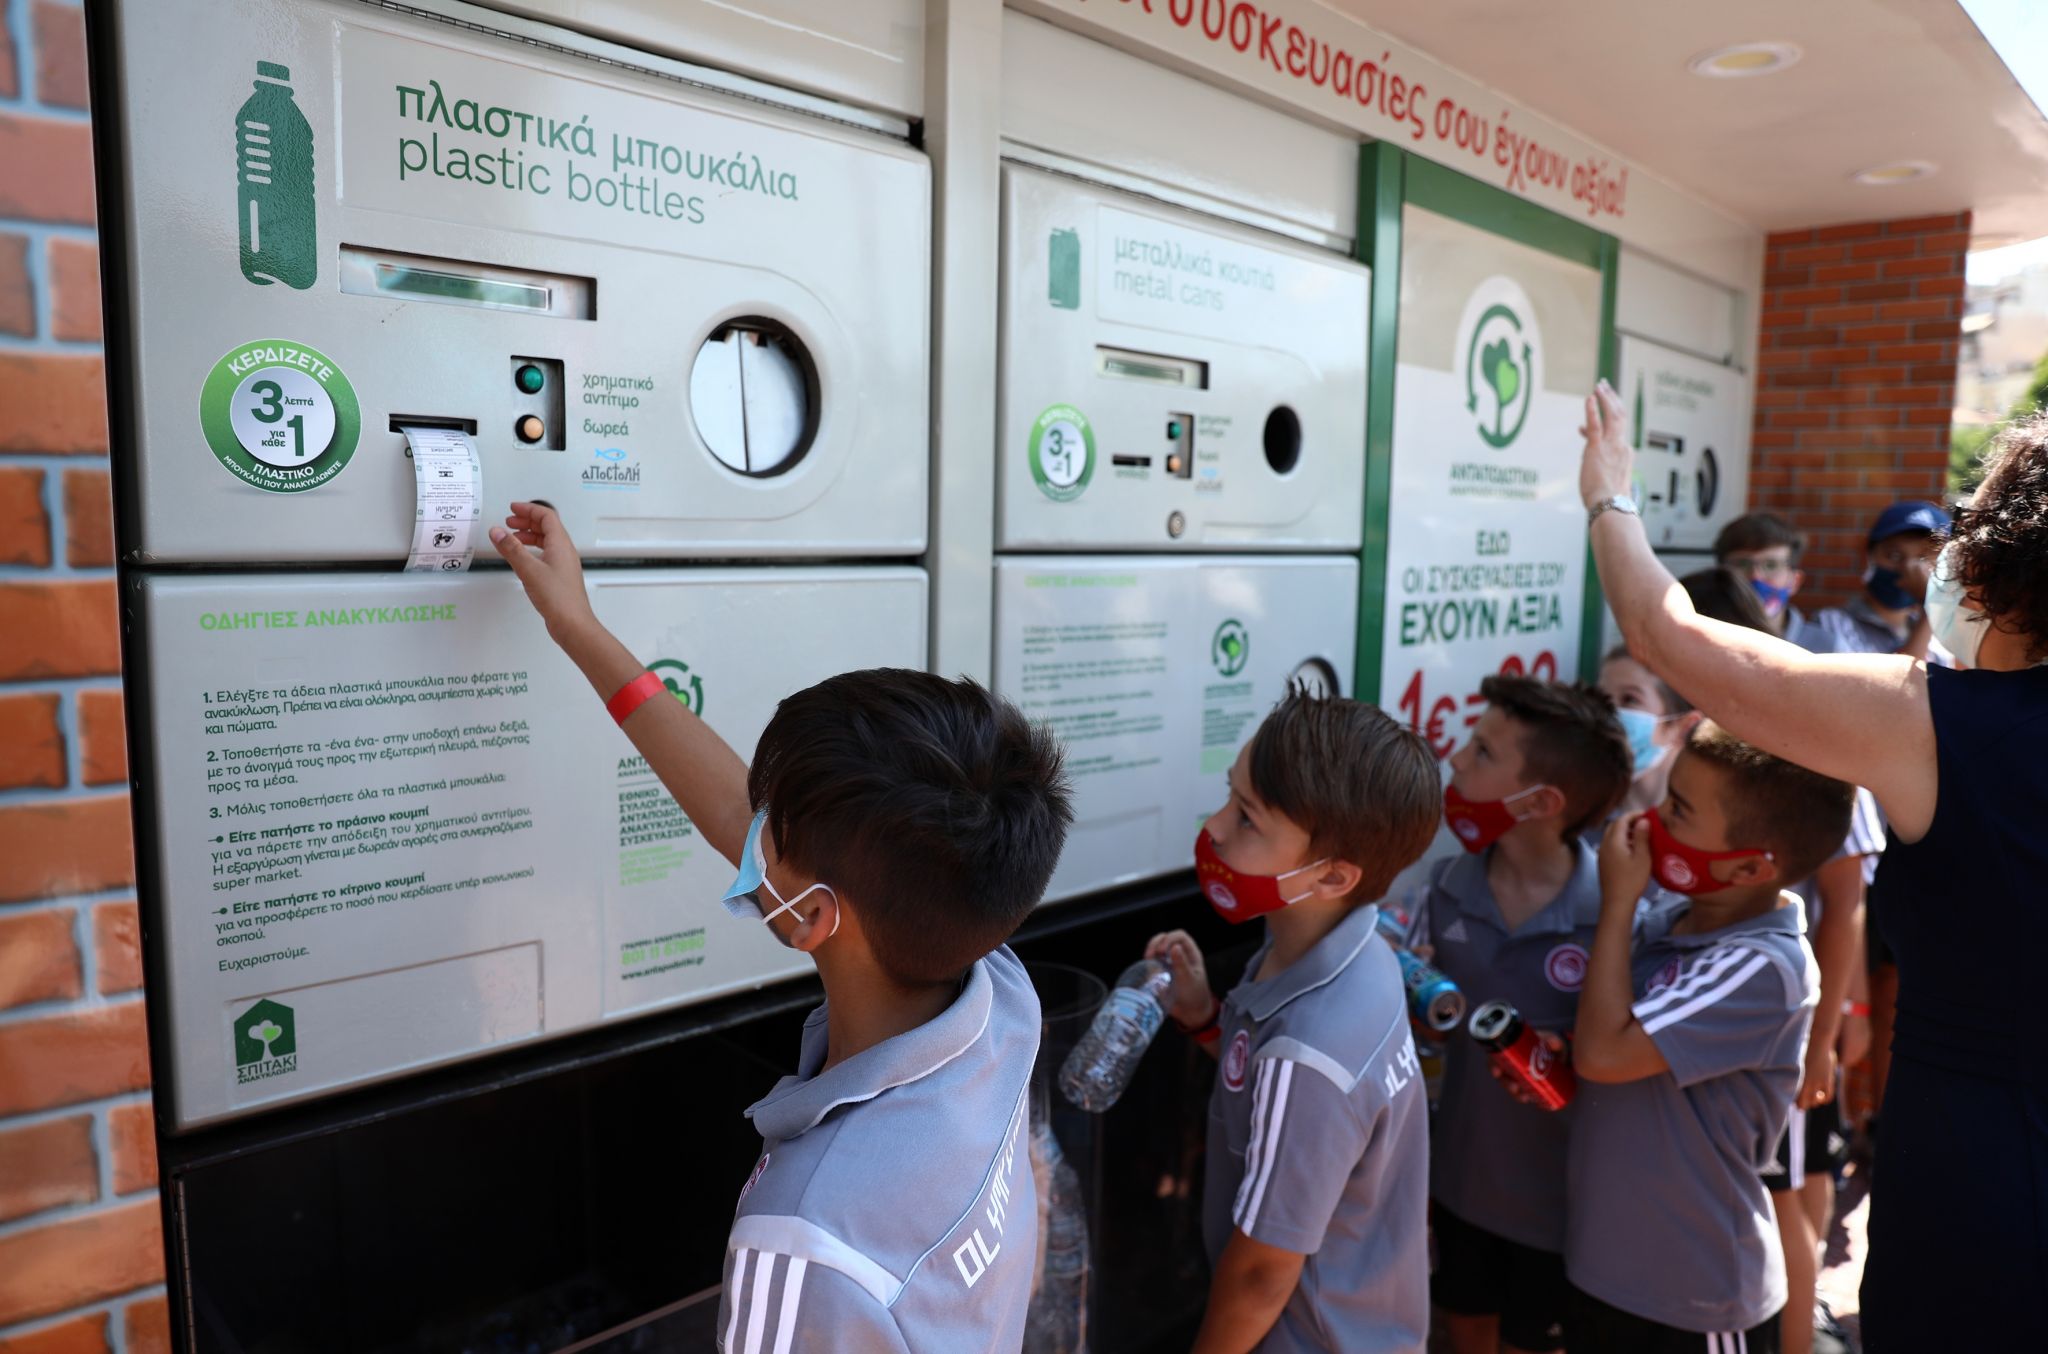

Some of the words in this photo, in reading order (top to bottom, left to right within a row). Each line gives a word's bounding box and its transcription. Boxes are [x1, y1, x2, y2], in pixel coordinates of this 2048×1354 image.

[396, 79, 597, 158] πλαστικά
[613, 133, 799, 201] μπουκάλια
[1434, 97, 1488, 156] σου
[1494, 110, 1569, 191] έχουν
[400, 132, 551, 195] plastic
[568, 160, 705, 224] bottles
[1114, 236, 1212, 277] μεταλλικά
[1219, 262, 1275, 291] κουτιά
[1114, 270, 1174, 301] metal
[1181, 282, 1224, 311] cans
[228, 347, 334, 383] ΚΕΡΔΙΖΕΤΕ
[583, 374, 654, 391] χρηματικό
[250, 380, 284, 424] 3
[284, 396, 314, 407] λεπτά
[583, 391, 639, 410] αντίτιμο
[261, 439, 286, 448] κάθε
[269, 430, 286, 439] για
[287, 415, 304, 457] 1
[583, 418, 629, 438] δωρεά
[1049, 429, 1063, 456] 3
[224, 455, 263, 485] ΜΠΟΥΚΑΛΙ
[263, 479, 282, 489] ΠΟΥ
[283, 460, 343, 489] ΑΝΑΚΥΚΛΩΝΕΤΕ
[253, 463, 314, 480] ΠΛΑΣΤΙΚΟ
[199, 611, 299, 631] ΟΔΗΓΙΕΣ
[304, 604, 457, 627] ΑΝΑΚΥΚΛΩΣΗΣ
[1400, 598, 1499, 646] ΕΧΟΥΝ
[1504, 593, 1562, 635] ΑΞΙΑ
[203, 692, 213, 704] 1.
[217, 689, 270, 703] Ελέγξτε
[272, 689, 287, 699] τα
[291, 685, 326, 698] άδεια
[329, 680, 382, 695] πλαστικά
[386, 676, 444, 692] μπουκάλια
[447, 673, 468, 686] που
[471, 671, 509, 686] φέρατε
[512, 670, 528, 682] για
[204, 704, 281, 720] ανακύκλωση.
[283, 701, 322, 715] Πρέπει
[324, 699, 337, 710] να
[339, 696, 363, 708] είναι
[418, 688, 475, 702] ασυμπίεστα
[476, 685, 504, 699] χωρίς
[505, 683, 528, 695] υγρά
[205, 724, 224, 735] και
[227, 719, 277, 734] πώματα.
[206, 750, 219, 763] 2.
[222, 743, 304, 761] Τοποθετήστε
[306, 741, 321, 752] τα
[383, 732, 409, 746] στην
[412, 726, 460, 740] υποδοχή
[463, 723, 496, 736] επάνω
[207, 766, 223, 780] με
[226, 765, 241, 776] το
[244, 758, 293, 774] άνοιγμά
[296, 756, 324, 768] τους
[327, 753, 356, 767] προς
[359, 750, 377, 762] την
[379, 743, 436, 760] εξωτερική
[438, 737, 478, 752] πλευρά,
[481, 734, 530, 748] πιέζοντας
[208, 780, 241, 795] προς
[245, 778, 259, 789] τα
[263, 773, 298, 789] μέσα.
[209, 806, 222, 819] 3.
[227, 803, 266, 817] Μόλις
[269, 792, 354, 812] τοποθετήσετε
[357, 787, 378, 801] όλα
[382, 786, 394, 797] τα
[398, 779, 446, 795] πλαστικά
[618, 788, 660, 802] ΕΘΝΙΚΟ
[211, 849, 232, 863] για
[236, 846, 252, 857] να
[257, 839, 303, 855] πάρετε
[307, 836, 328, 849] την
[331, 826, 387, 845] απόδειξη
[391, 823, 411, 835] του
[414, 812, 478, 834] χρηματικού
[229, 830, 257, 844] Είτε
[260, 824, 315, 840] πατήστε
[318, 821, 333, 831] το
[336, 813, 386, 830] πράσινο
[389, 805, 429, 822] κουμπί
[213, 864, 224, 876] Η
[227, 854, 302, 875] εξαργύρωση
[304, 848, 340, 864] γίνεται
[343, 846, 355, 859] με
[358, 838, 399, 855] δωρεάν
[401, 833, 438, 849] αγορές
[440, 831, 458, 841] στα
[460, 819, 533, 839] συνεργαζόμενα
[212, 876, 250, 891] super
[254, 867, 302, 884] market.
[233, 901, 260, 915] Είτε
[264, 893, 318, 909] πατήστε
[322, 889, 336, 899] το
[340, 881, 381, 897] κίτρινο
[385, 872, 425, 889] κουμπί
[215, 920, 235, 934] για
[237, 918, 252, 929] να
[255, 905, 328, 926] προσφέρετε
[330, 902, 343, 912] το
[346, 895, 375, 910] ποσό
[377, 893, 398, 904] που
[400, 882, 453, 902] κερδίσατε
[455, 877, 480, 890] υπέρ
[216, 928, 266, 947] σκοπού.
[218, 946, 310, 972] Ευχαριστούμε.
[236, 1054, 297, 1079] ΣΠΙΤΑΚΙ
